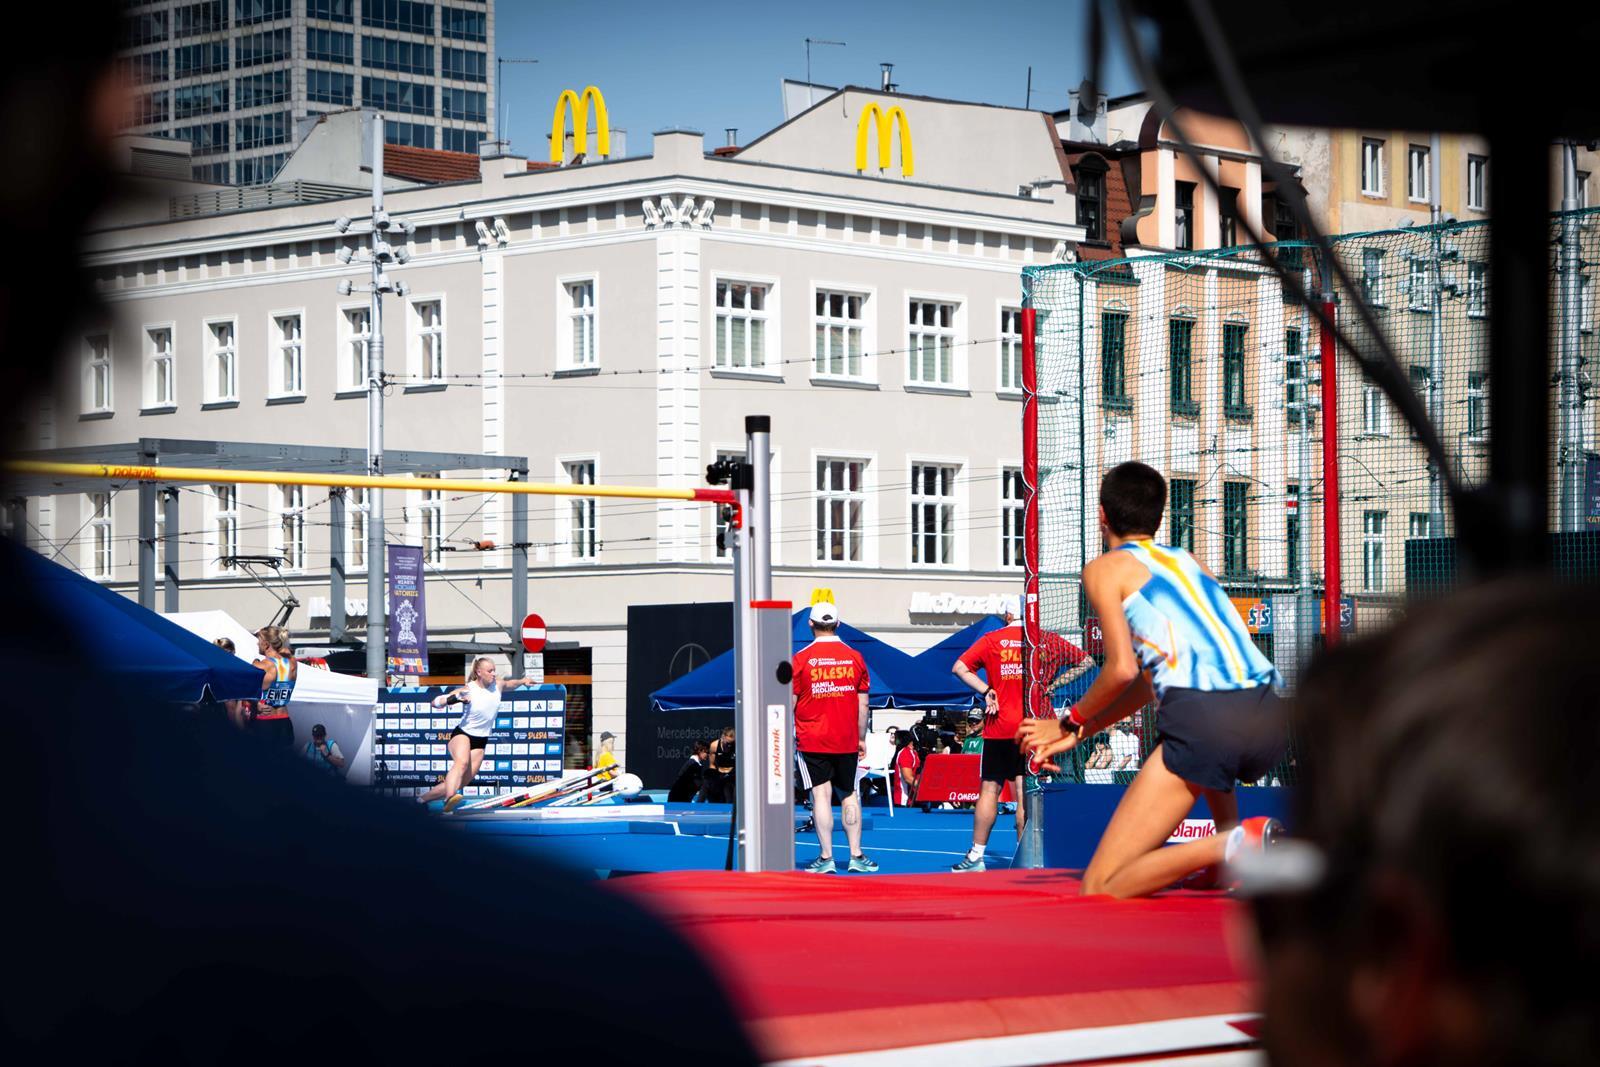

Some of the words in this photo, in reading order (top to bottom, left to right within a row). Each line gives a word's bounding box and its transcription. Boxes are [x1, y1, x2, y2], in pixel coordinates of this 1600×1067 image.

[112, 467, 157, 478] polanik
[909, 592, 1008, 613] McDonald
[811, 667, 854, 681] SILESIA
[267, 689, 292, 700] EWEN
[527, 731, 547, 740] SILESIA
[968, 740, 979, 749] TV
[656, 746, 691, 759] Duda-C
[772, 728, 782, 777] polanik
[526, 775, 546, 783] SILESIA
[1171, 822, 1217, 838] olanik
